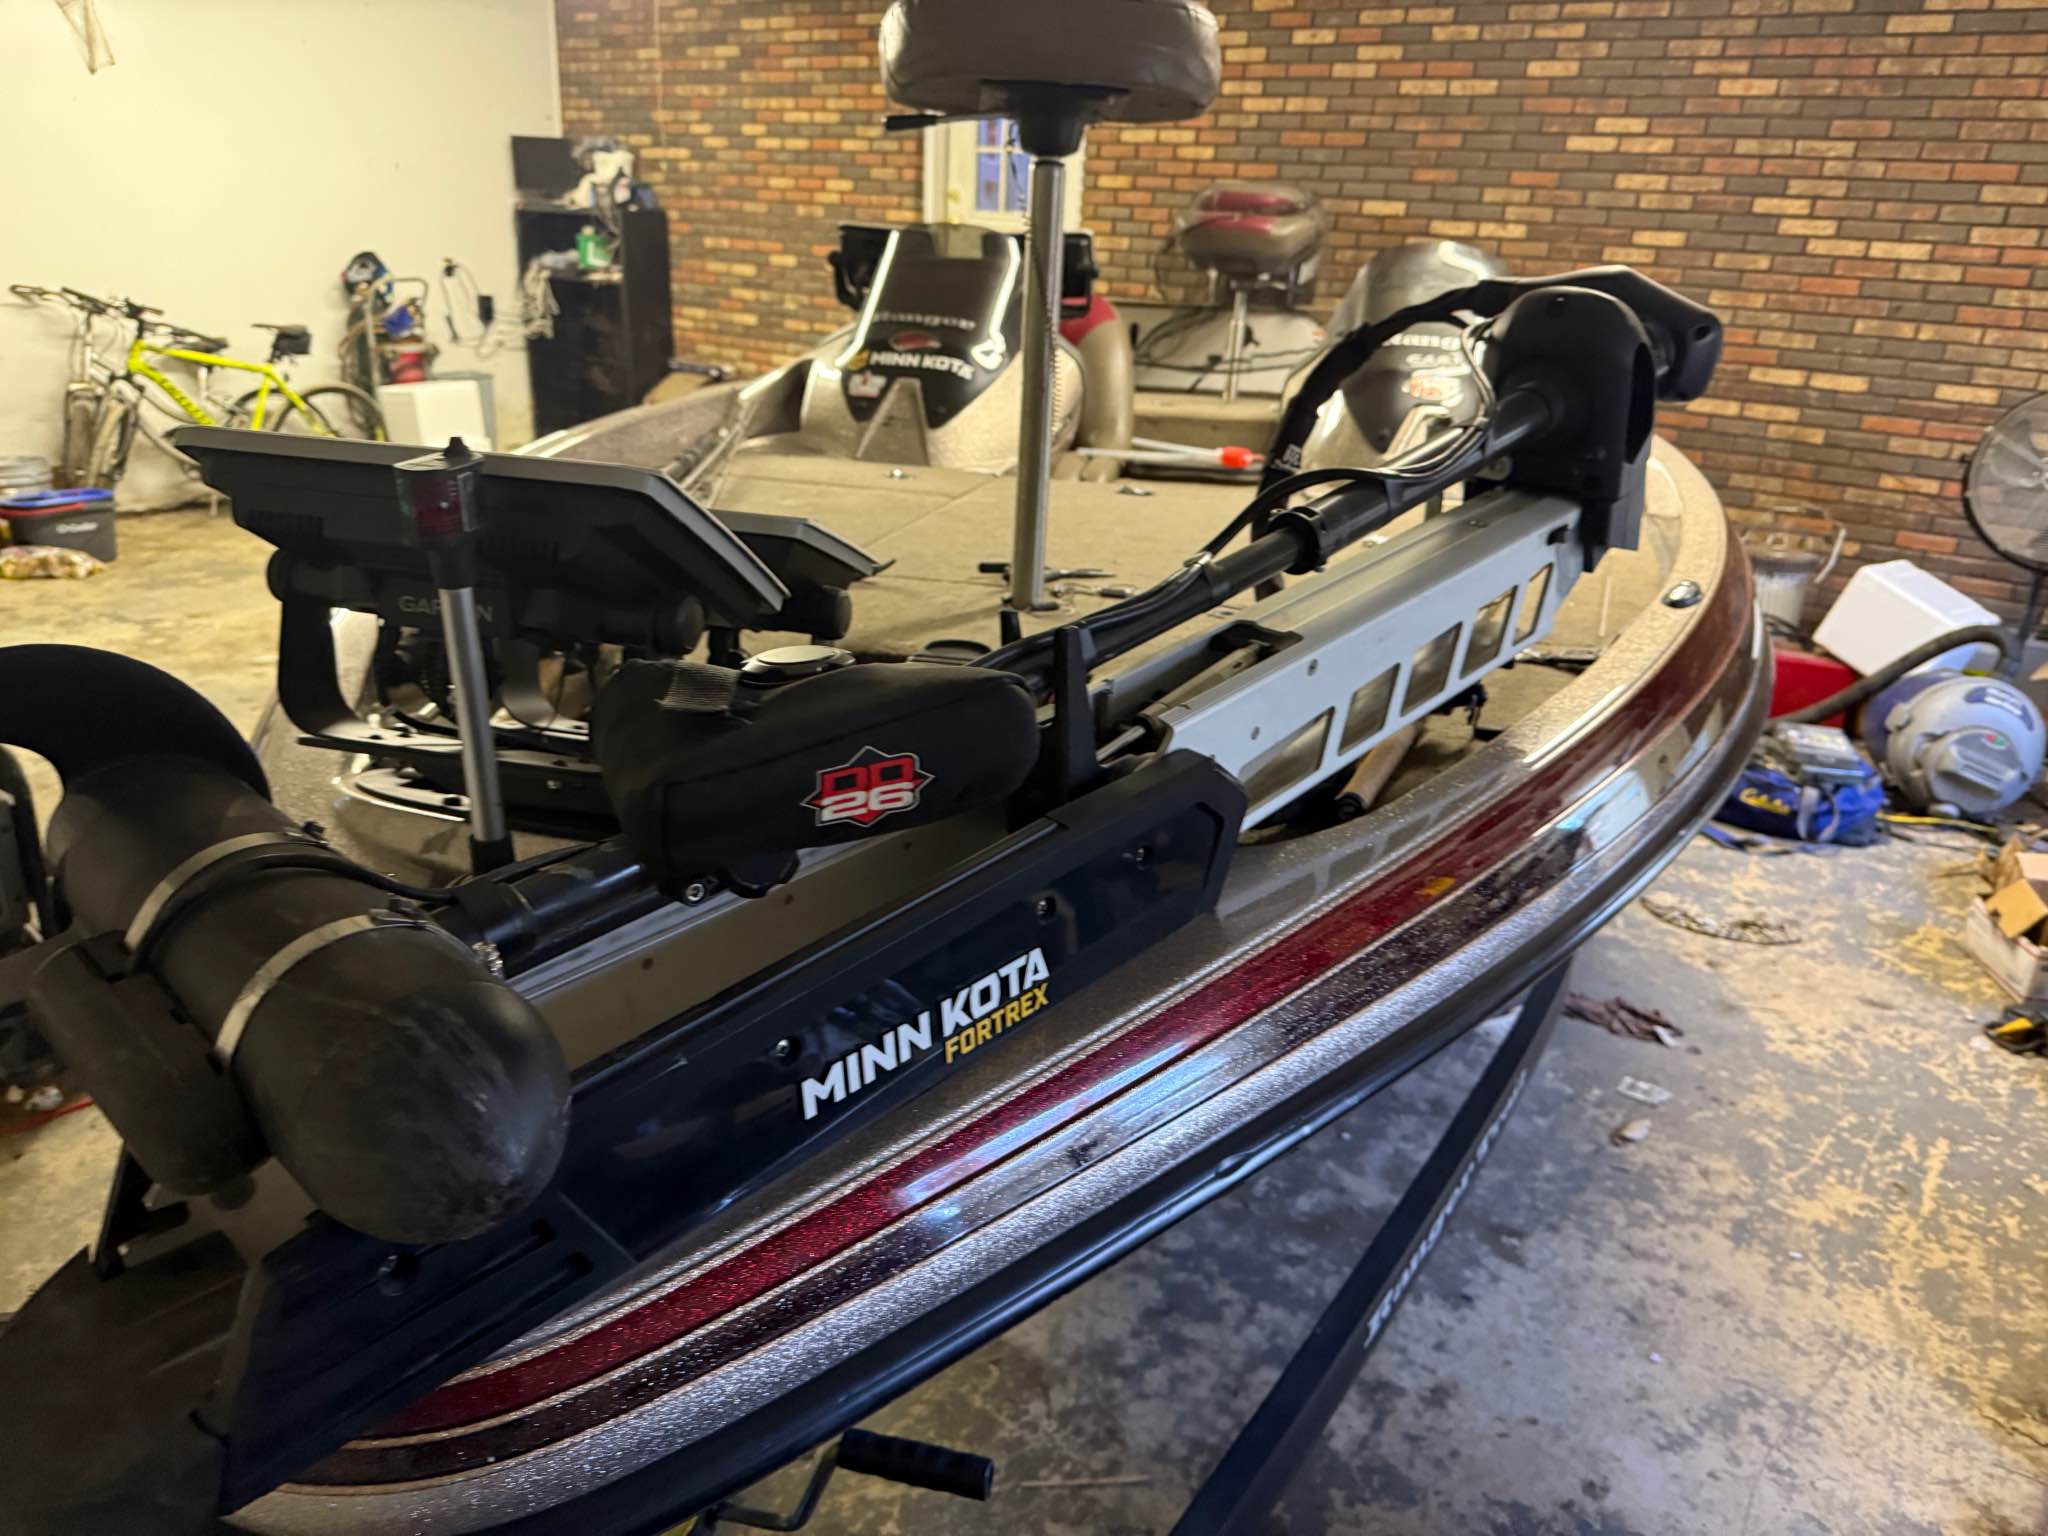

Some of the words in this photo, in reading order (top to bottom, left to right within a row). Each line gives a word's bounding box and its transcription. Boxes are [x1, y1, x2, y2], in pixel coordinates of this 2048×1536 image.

[869, 351, 921, 368] MINN
[922, 353, 976, 380] KOTA
[820, 781, 914, 821] 26
[801, 1010, 933, 1121] MINN
[940, 947, 1050, 1038] KOTA
[945, 983, 1049, 1064] FORTREX
